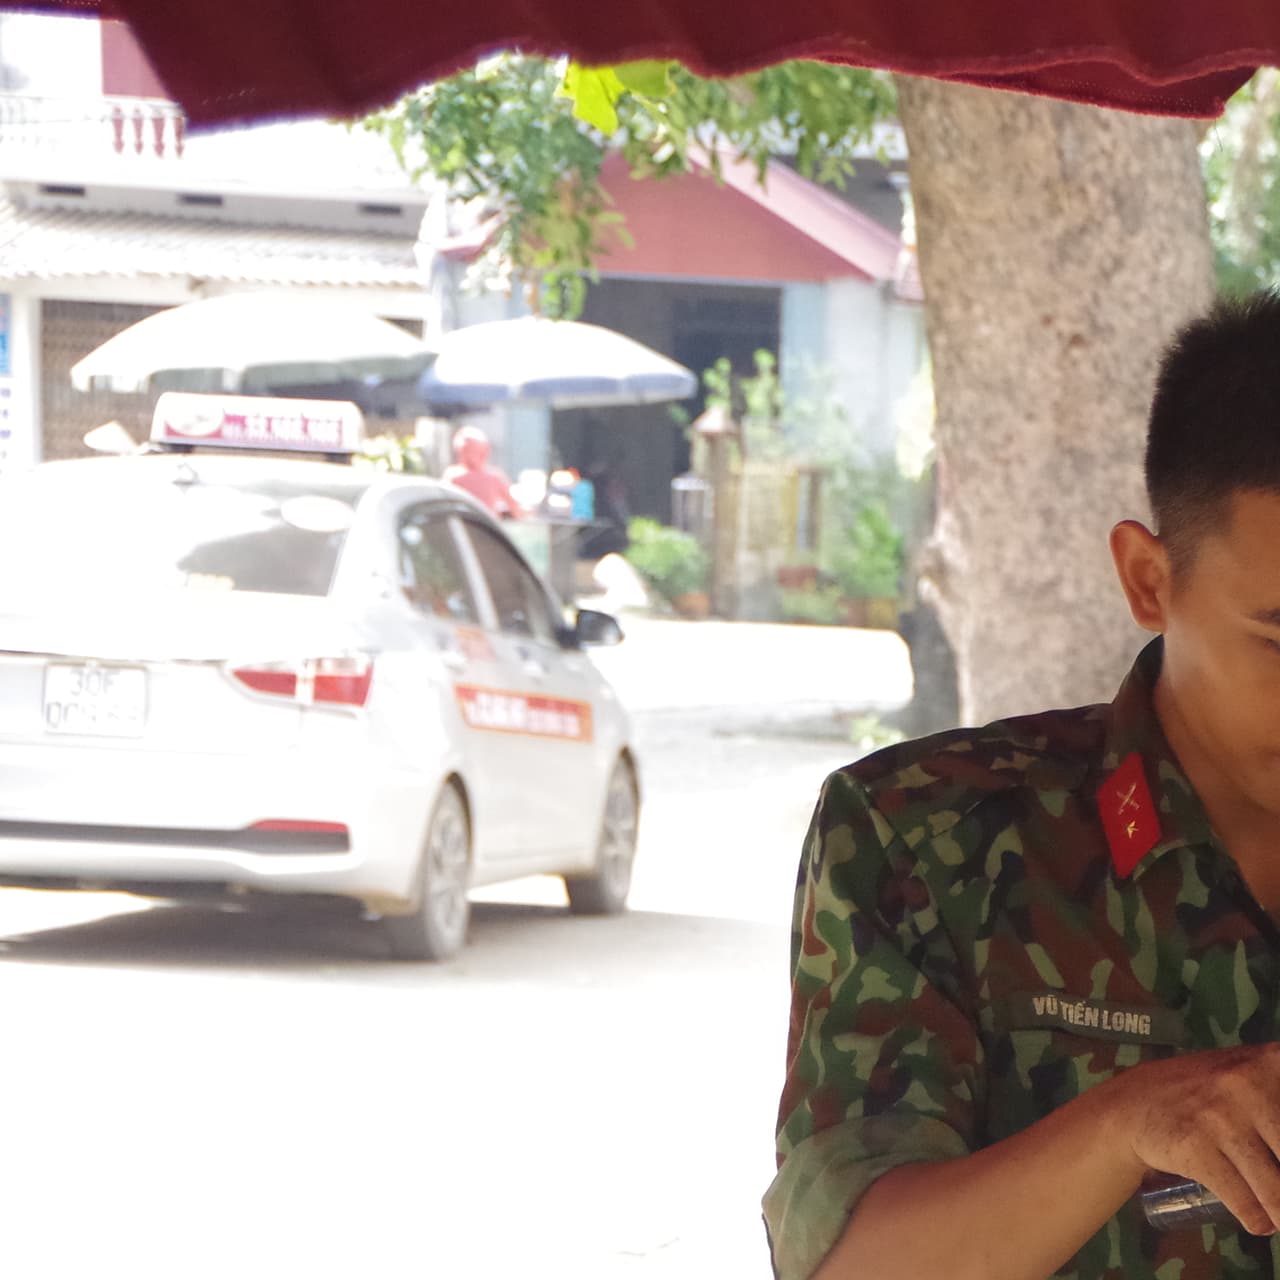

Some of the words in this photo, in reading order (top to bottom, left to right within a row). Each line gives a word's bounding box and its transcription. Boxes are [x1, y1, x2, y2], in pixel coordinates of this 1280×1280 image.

[1032, 994, 1059, 1016] VŨ
[1060, 1000, 1099, 1028] TIẾN
[1102, 1010, 1151, 1036] LONG
